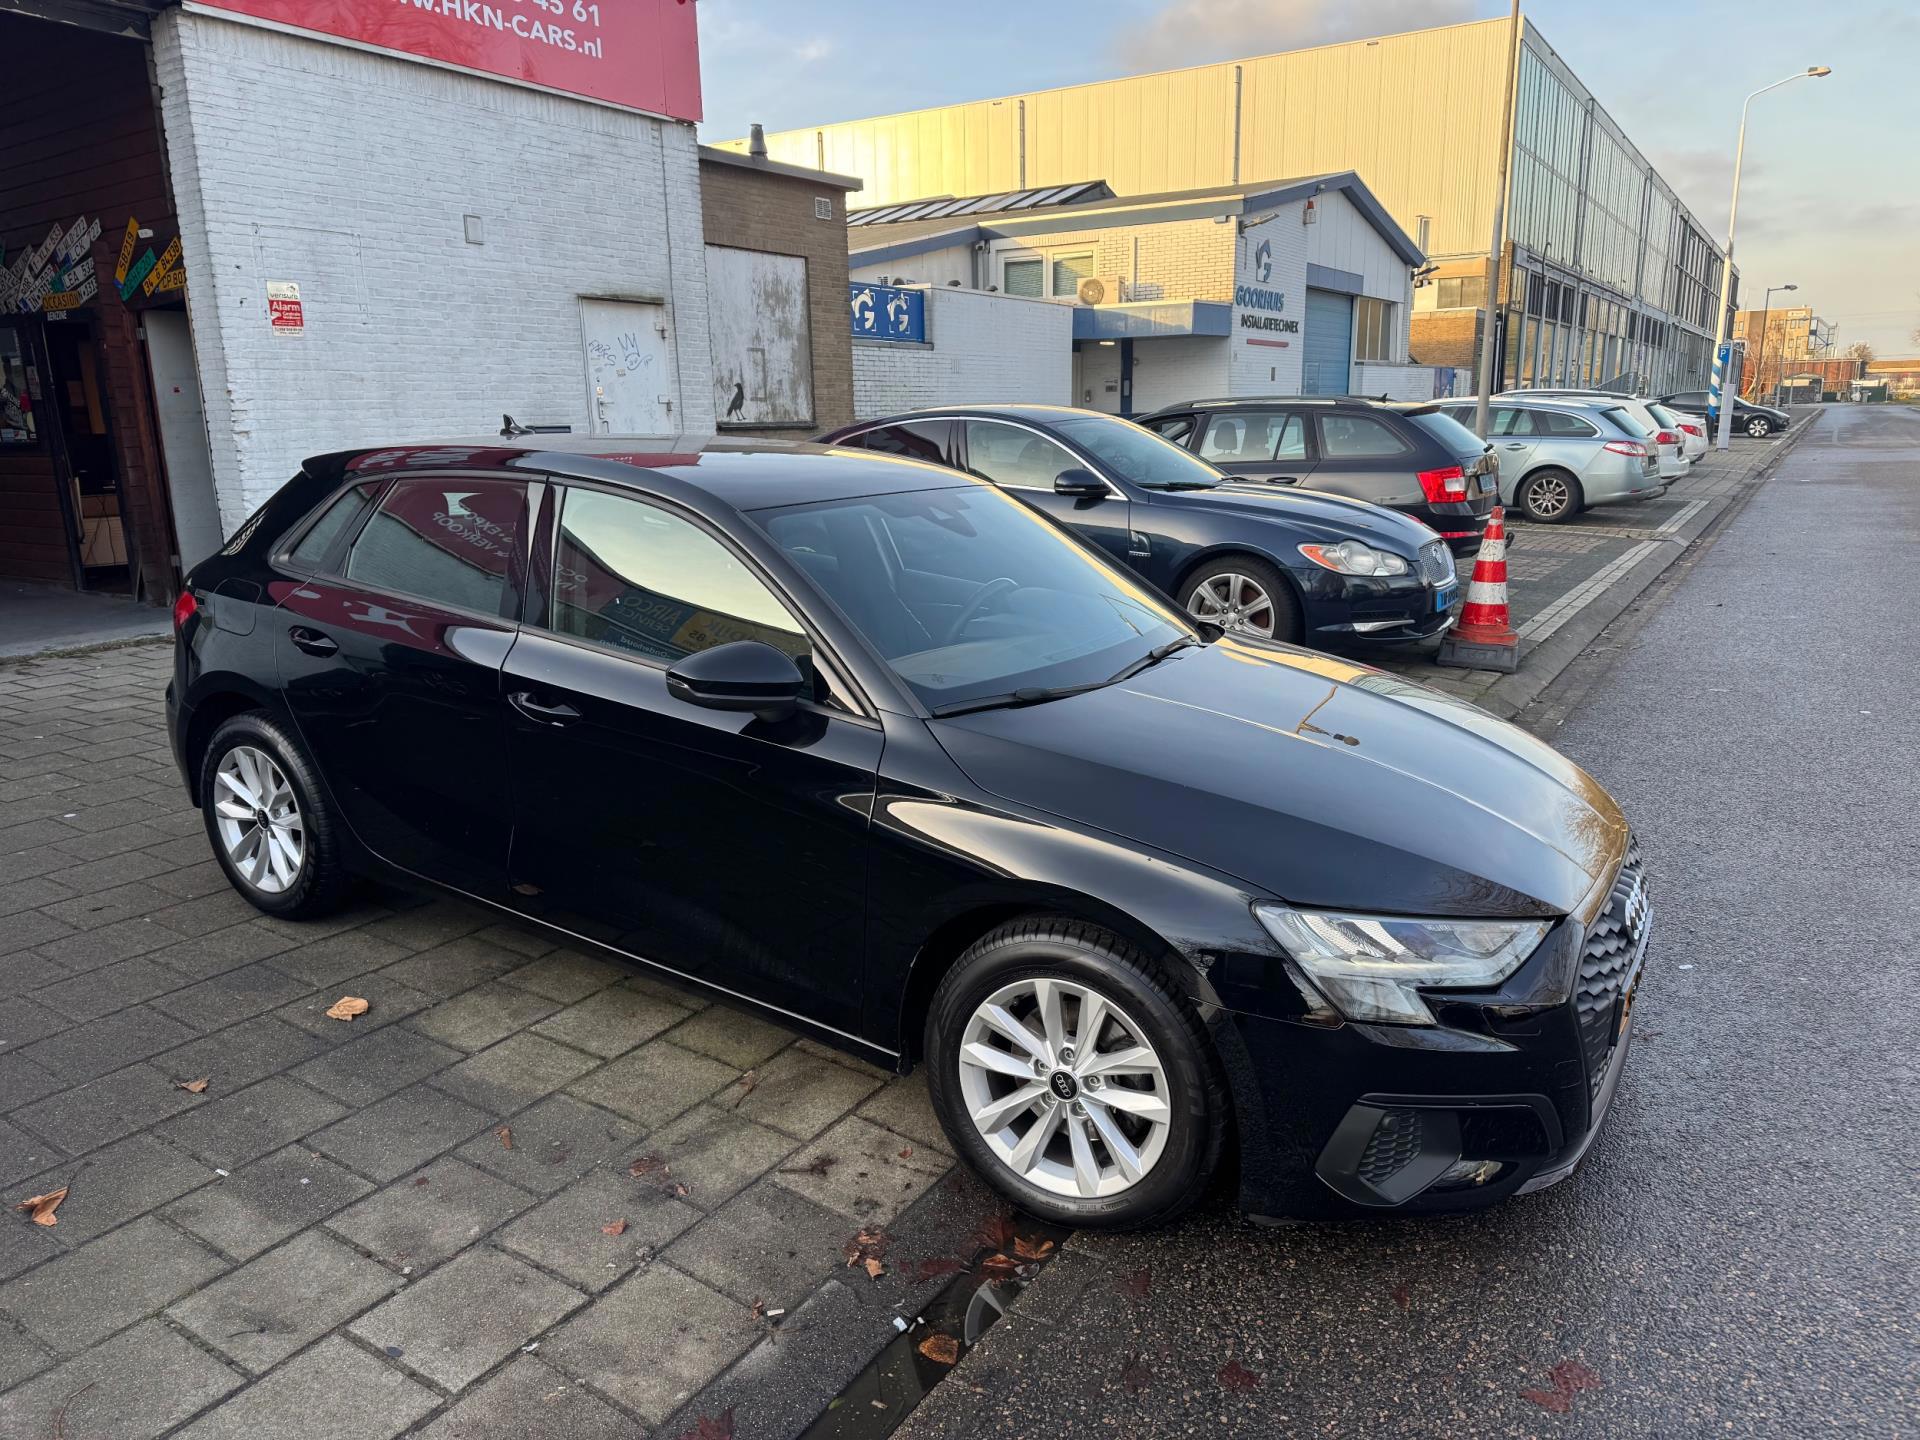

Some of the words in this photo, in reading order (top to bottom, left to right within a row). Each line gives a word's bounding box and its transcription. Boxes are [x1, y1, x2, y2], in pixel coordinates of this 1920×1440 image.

[572, 0, 600, 27] 61
[272, 301, 301, 312] Alarm
[1235, 285, 1285, 313] GOORHUIS
[1719, 348, 1727, 358] P
